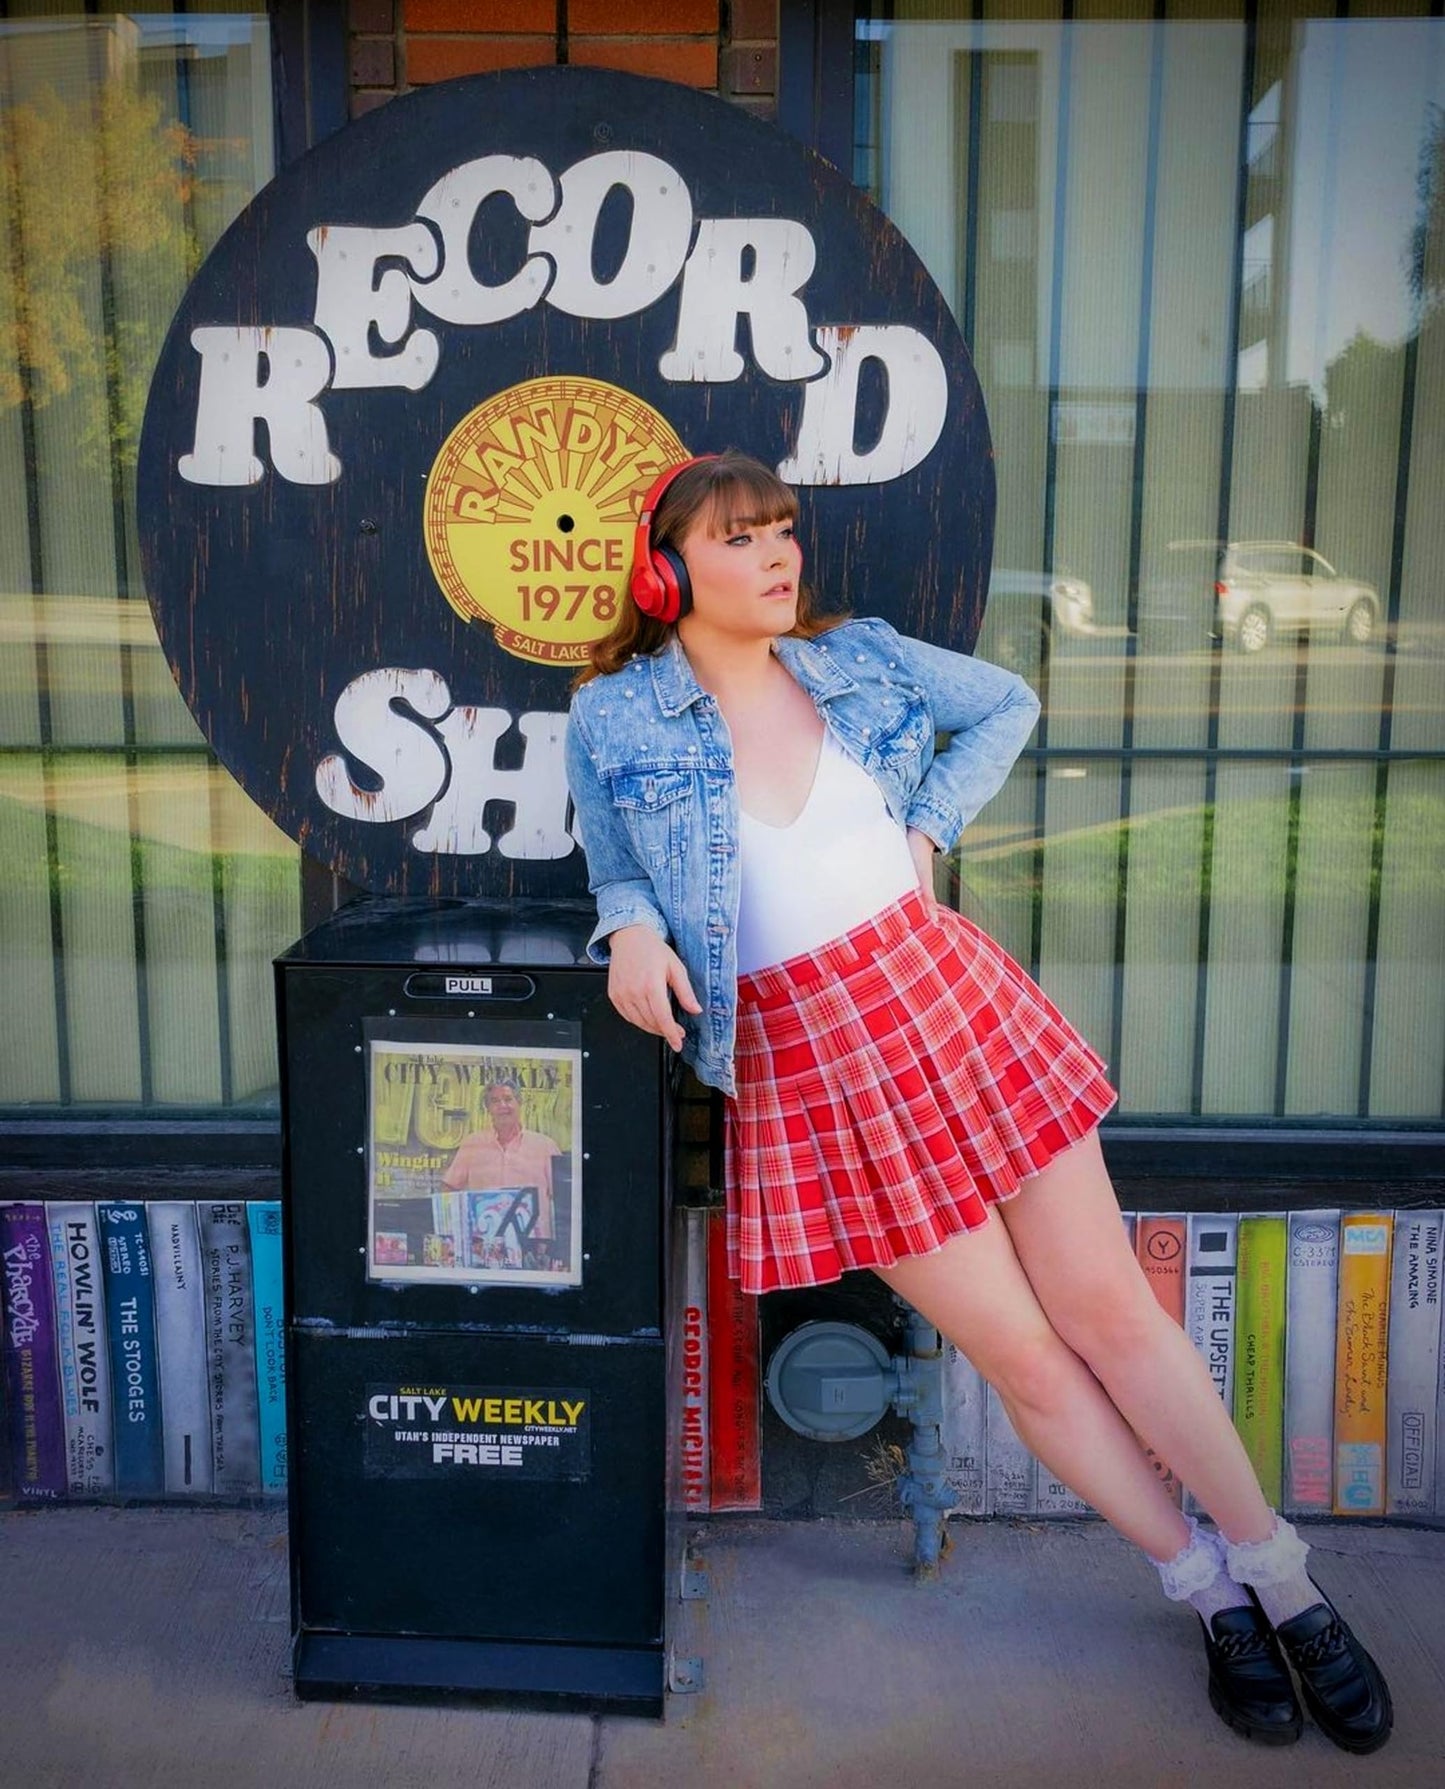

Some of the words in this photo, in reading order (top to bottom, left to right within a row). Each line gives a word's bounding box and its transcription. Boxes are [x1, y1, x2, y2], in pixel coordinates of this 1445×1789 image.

[178, 150, 948, 487] RECORD
[510, 539, 623, 572] SINCE
[517, 585, 617, 621] 1978
[512, 634, 545, 656] SALT
[550, 644, 589, 659] LAKE
[449, 980, 490, 991] PULL
[385, 1063, 439, 1085] CITY
[454, 1064, 560, 1089] WEEKLY
[26, 1234, 41, 1260] The
[52, 1224, 64, 1252] THE
[1410, 1225, 1420, 1249] THE
[1426, 1227, 1438, 1254] NINA
[55, 1261, 69, 1303] REAL
[68, 1223, 96, 1334] HOWLIN'
[211, 1248, 223, 1293] STORIES
[1409, 1254, 1419, 1309] AMAZING
[1426, 1258, 1438, 1305] SIMONE
[120, 1297, 138, 1334] THE
[213, 1297, 223, 1326] FROM
[1196, 1285, 1207, 1320] SUPER
[1211, 1281, 1231, 1321] THE
[59, 1310, 76, 1361] FOLK
[215, 1328, 224, 1345] THE
[1245, 1334, 1256, 1366] CHEAP
[65, 1366, 78, 1416] BLUES
[77, 1341, 99, 1413] WOLF
[123, 1340, 145, 1422] STOOGES
[400, 1387, 422, 1395] SALT
[423, 1388, 447, 1396] LAKE
[369, 1395, 447, 1421] CITY
[452, 1397, 585, 1425] WEEKLY
[1245, 1371, 1256, 1420] THRILLS
[394, 1432, 429, 1442] UTAH'S
[432, 1433, 498, 1444] INDEPENDENT
[501, 1435, 560, 1446] NEWSPAPER
[433, 1444, 523, 1466] FREE
[1404, 1416, 1421, 1487] OFFICIAL
